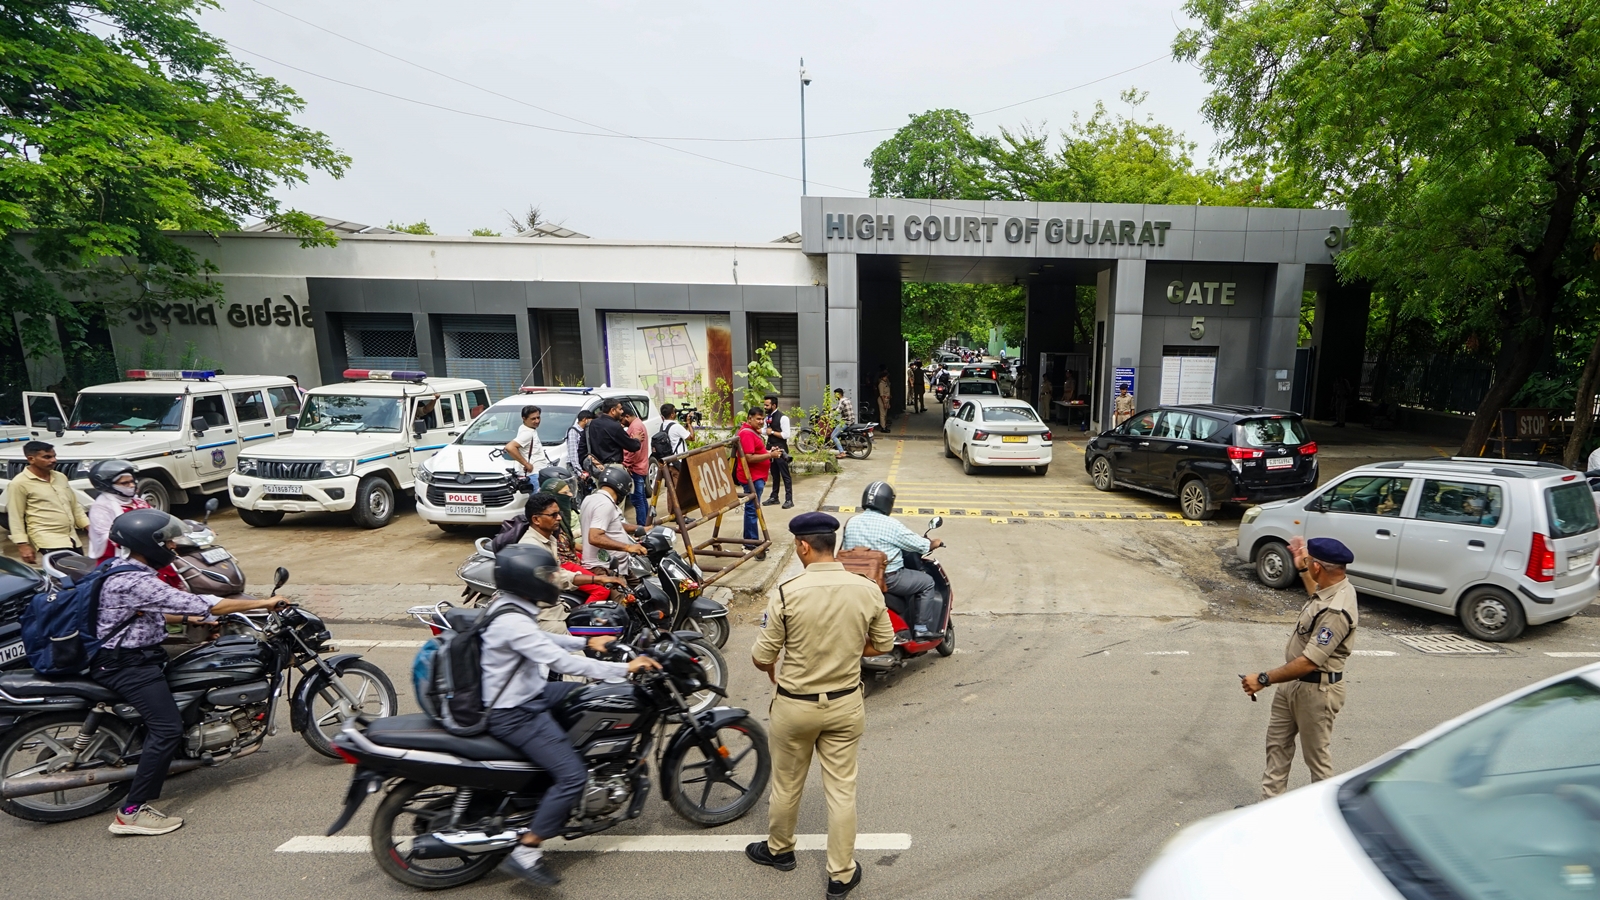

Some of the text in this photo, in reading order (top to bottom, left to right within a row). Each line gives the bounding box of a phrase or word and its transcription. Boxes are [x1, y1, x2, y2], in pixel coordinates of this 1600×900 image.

[826, 213, 1171, 247] HIGH COURT OF GUJARAT
[1166, 280, 1236, 306] GATE
[1190, 316, 1205, 340] 5
[1520, 415, 1546, 435] STOP
[697, 456, 732, 504] STOP
